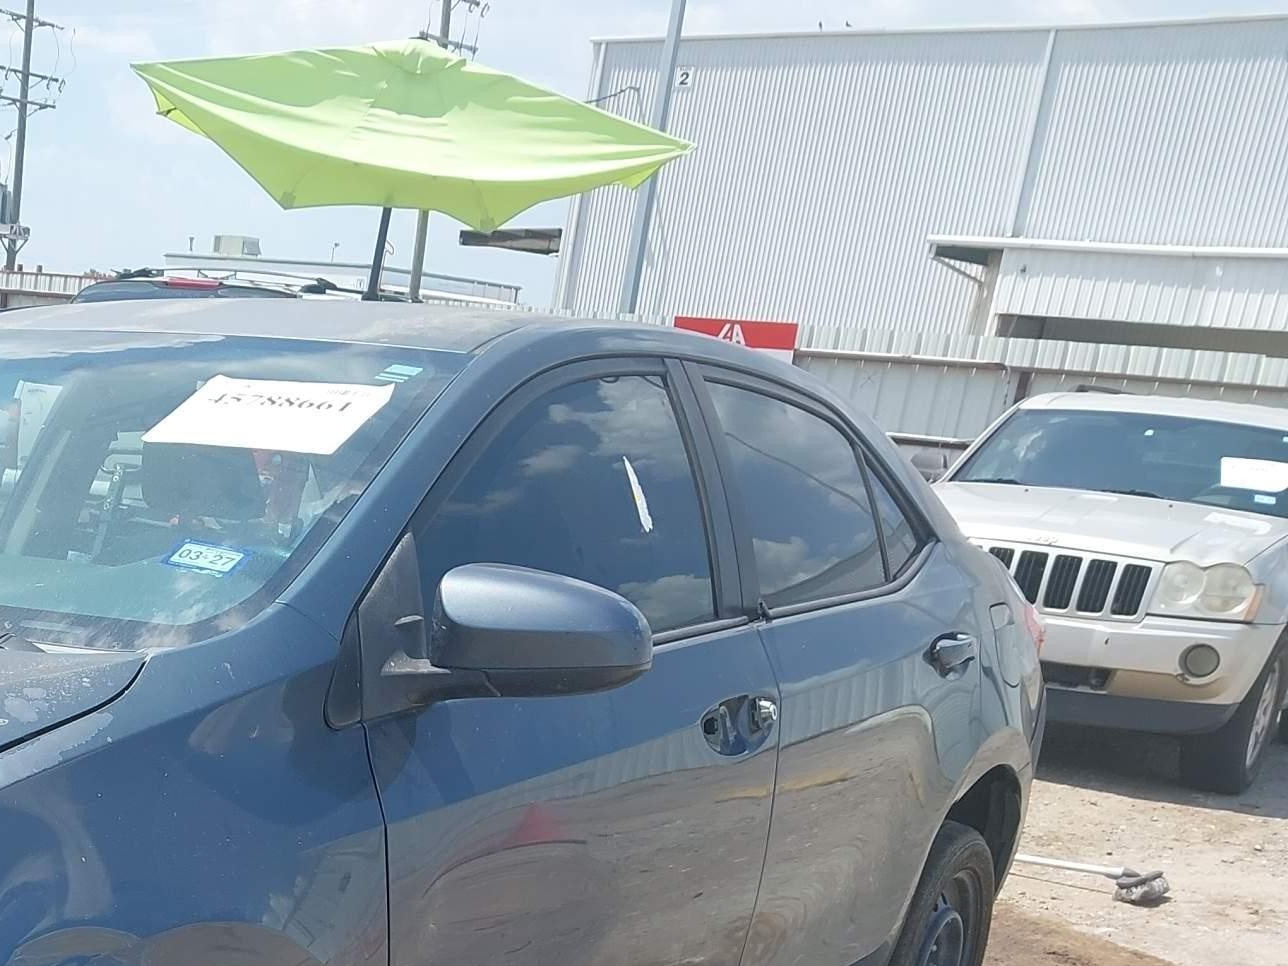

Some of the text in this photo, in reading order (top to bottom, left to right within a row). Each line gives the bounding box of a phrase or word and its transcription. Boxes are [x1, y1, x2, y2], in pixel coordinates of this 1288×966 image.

[679, 71, 689, 86] 2
[178, 548, 236, 567] 03 27
